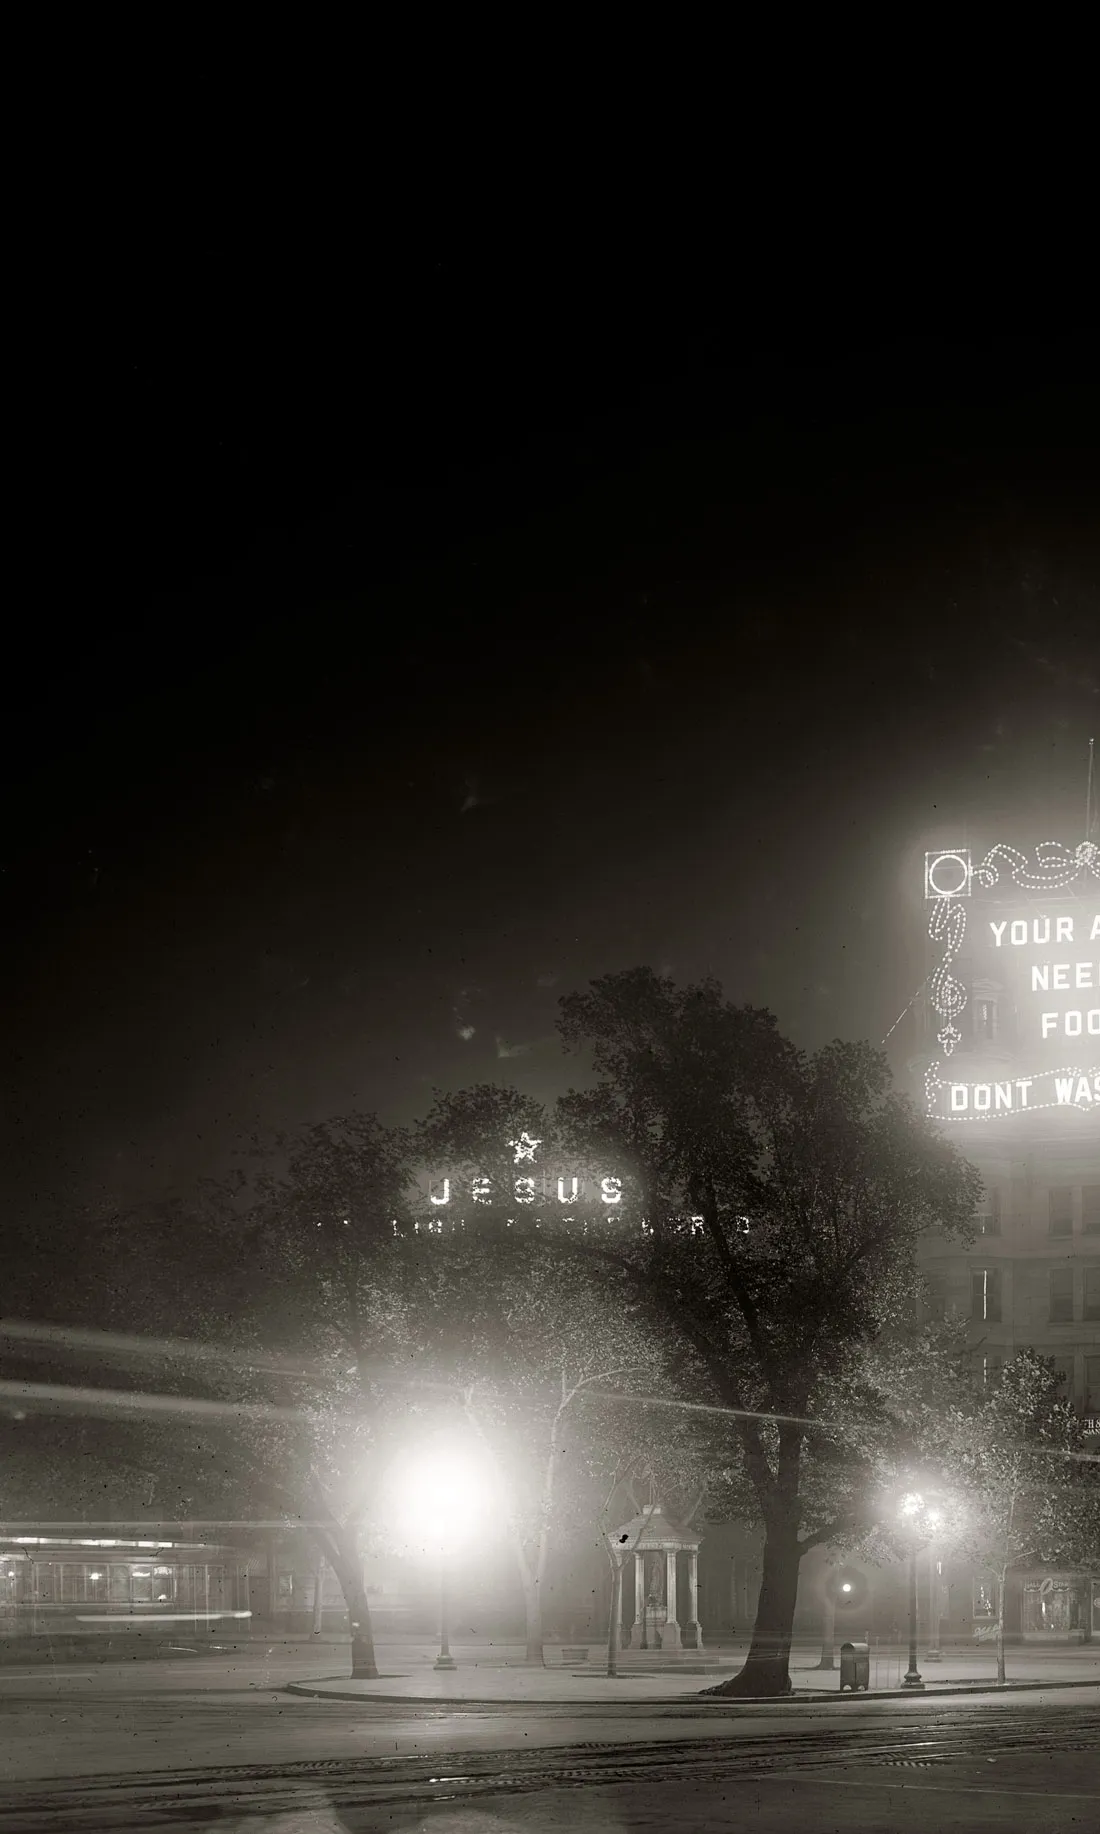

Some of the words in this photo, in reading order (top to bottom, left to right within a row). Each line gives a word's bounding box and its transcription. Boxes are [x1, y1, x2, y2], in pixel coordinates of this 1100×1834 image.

[989, 916, 1074, 947] YOUR
[950, 1081, 1033, 1111] DONT
[429, 1177, 622, 1205] JESUS
